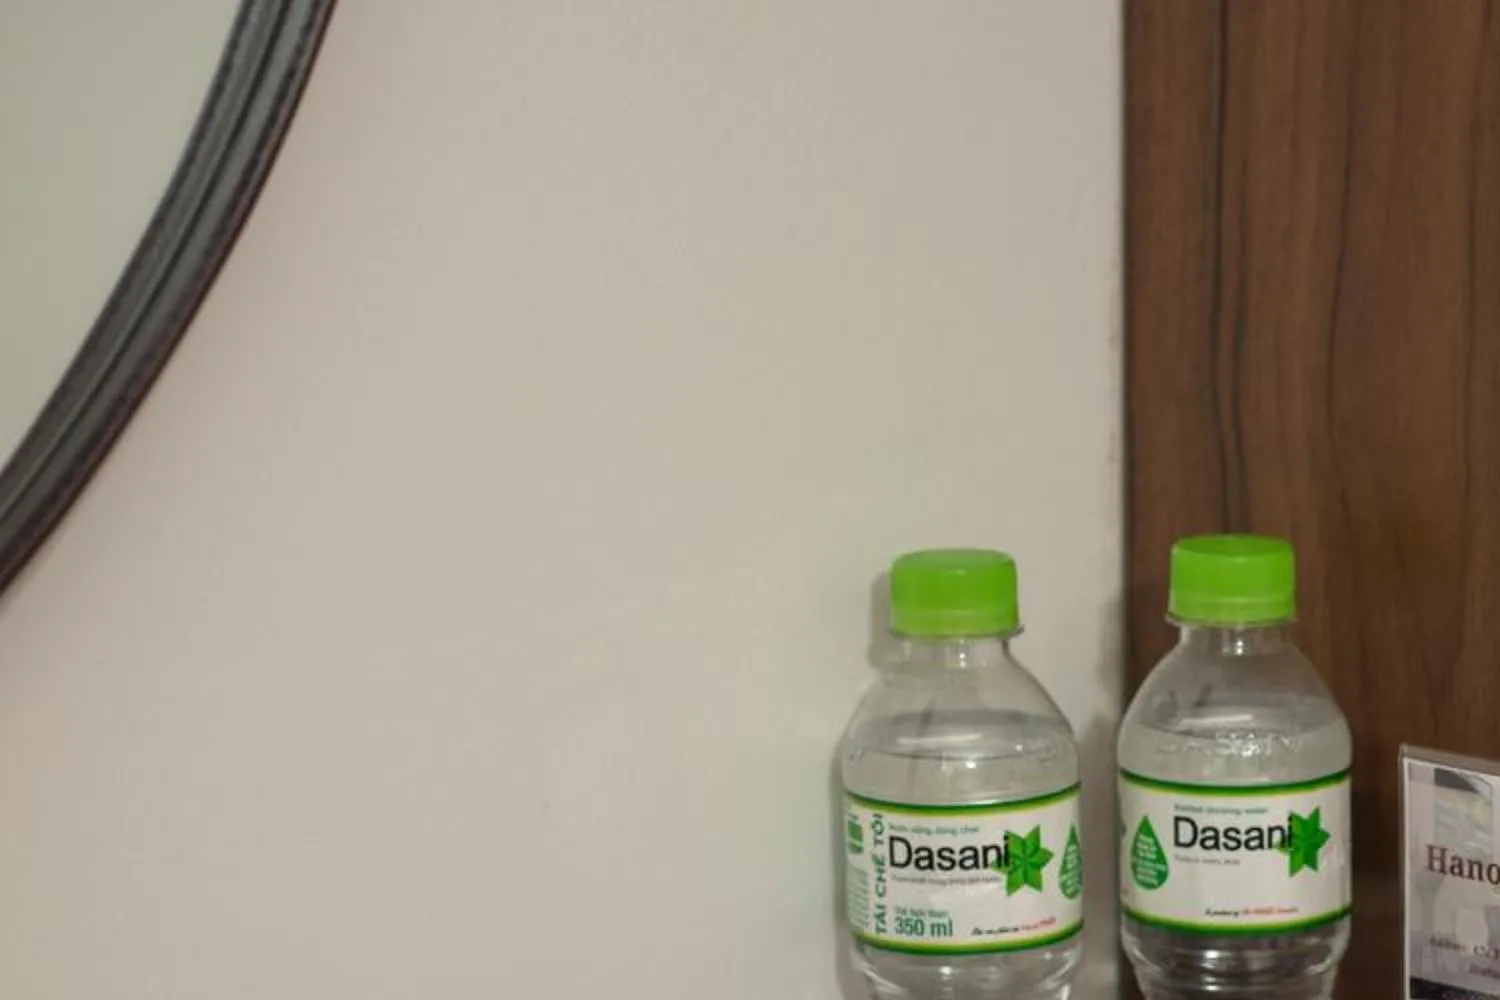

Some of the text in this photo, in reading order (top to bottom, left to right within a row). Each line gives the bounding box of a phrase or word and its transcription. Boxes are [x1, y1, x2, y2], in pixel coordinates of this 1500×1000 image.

[1173, 815, 1293, 851] Dasani
[888, 834, 1010, 872] Dasani
[894, 917, 925, 937] 350
[929, 917, 954, 938] ml
